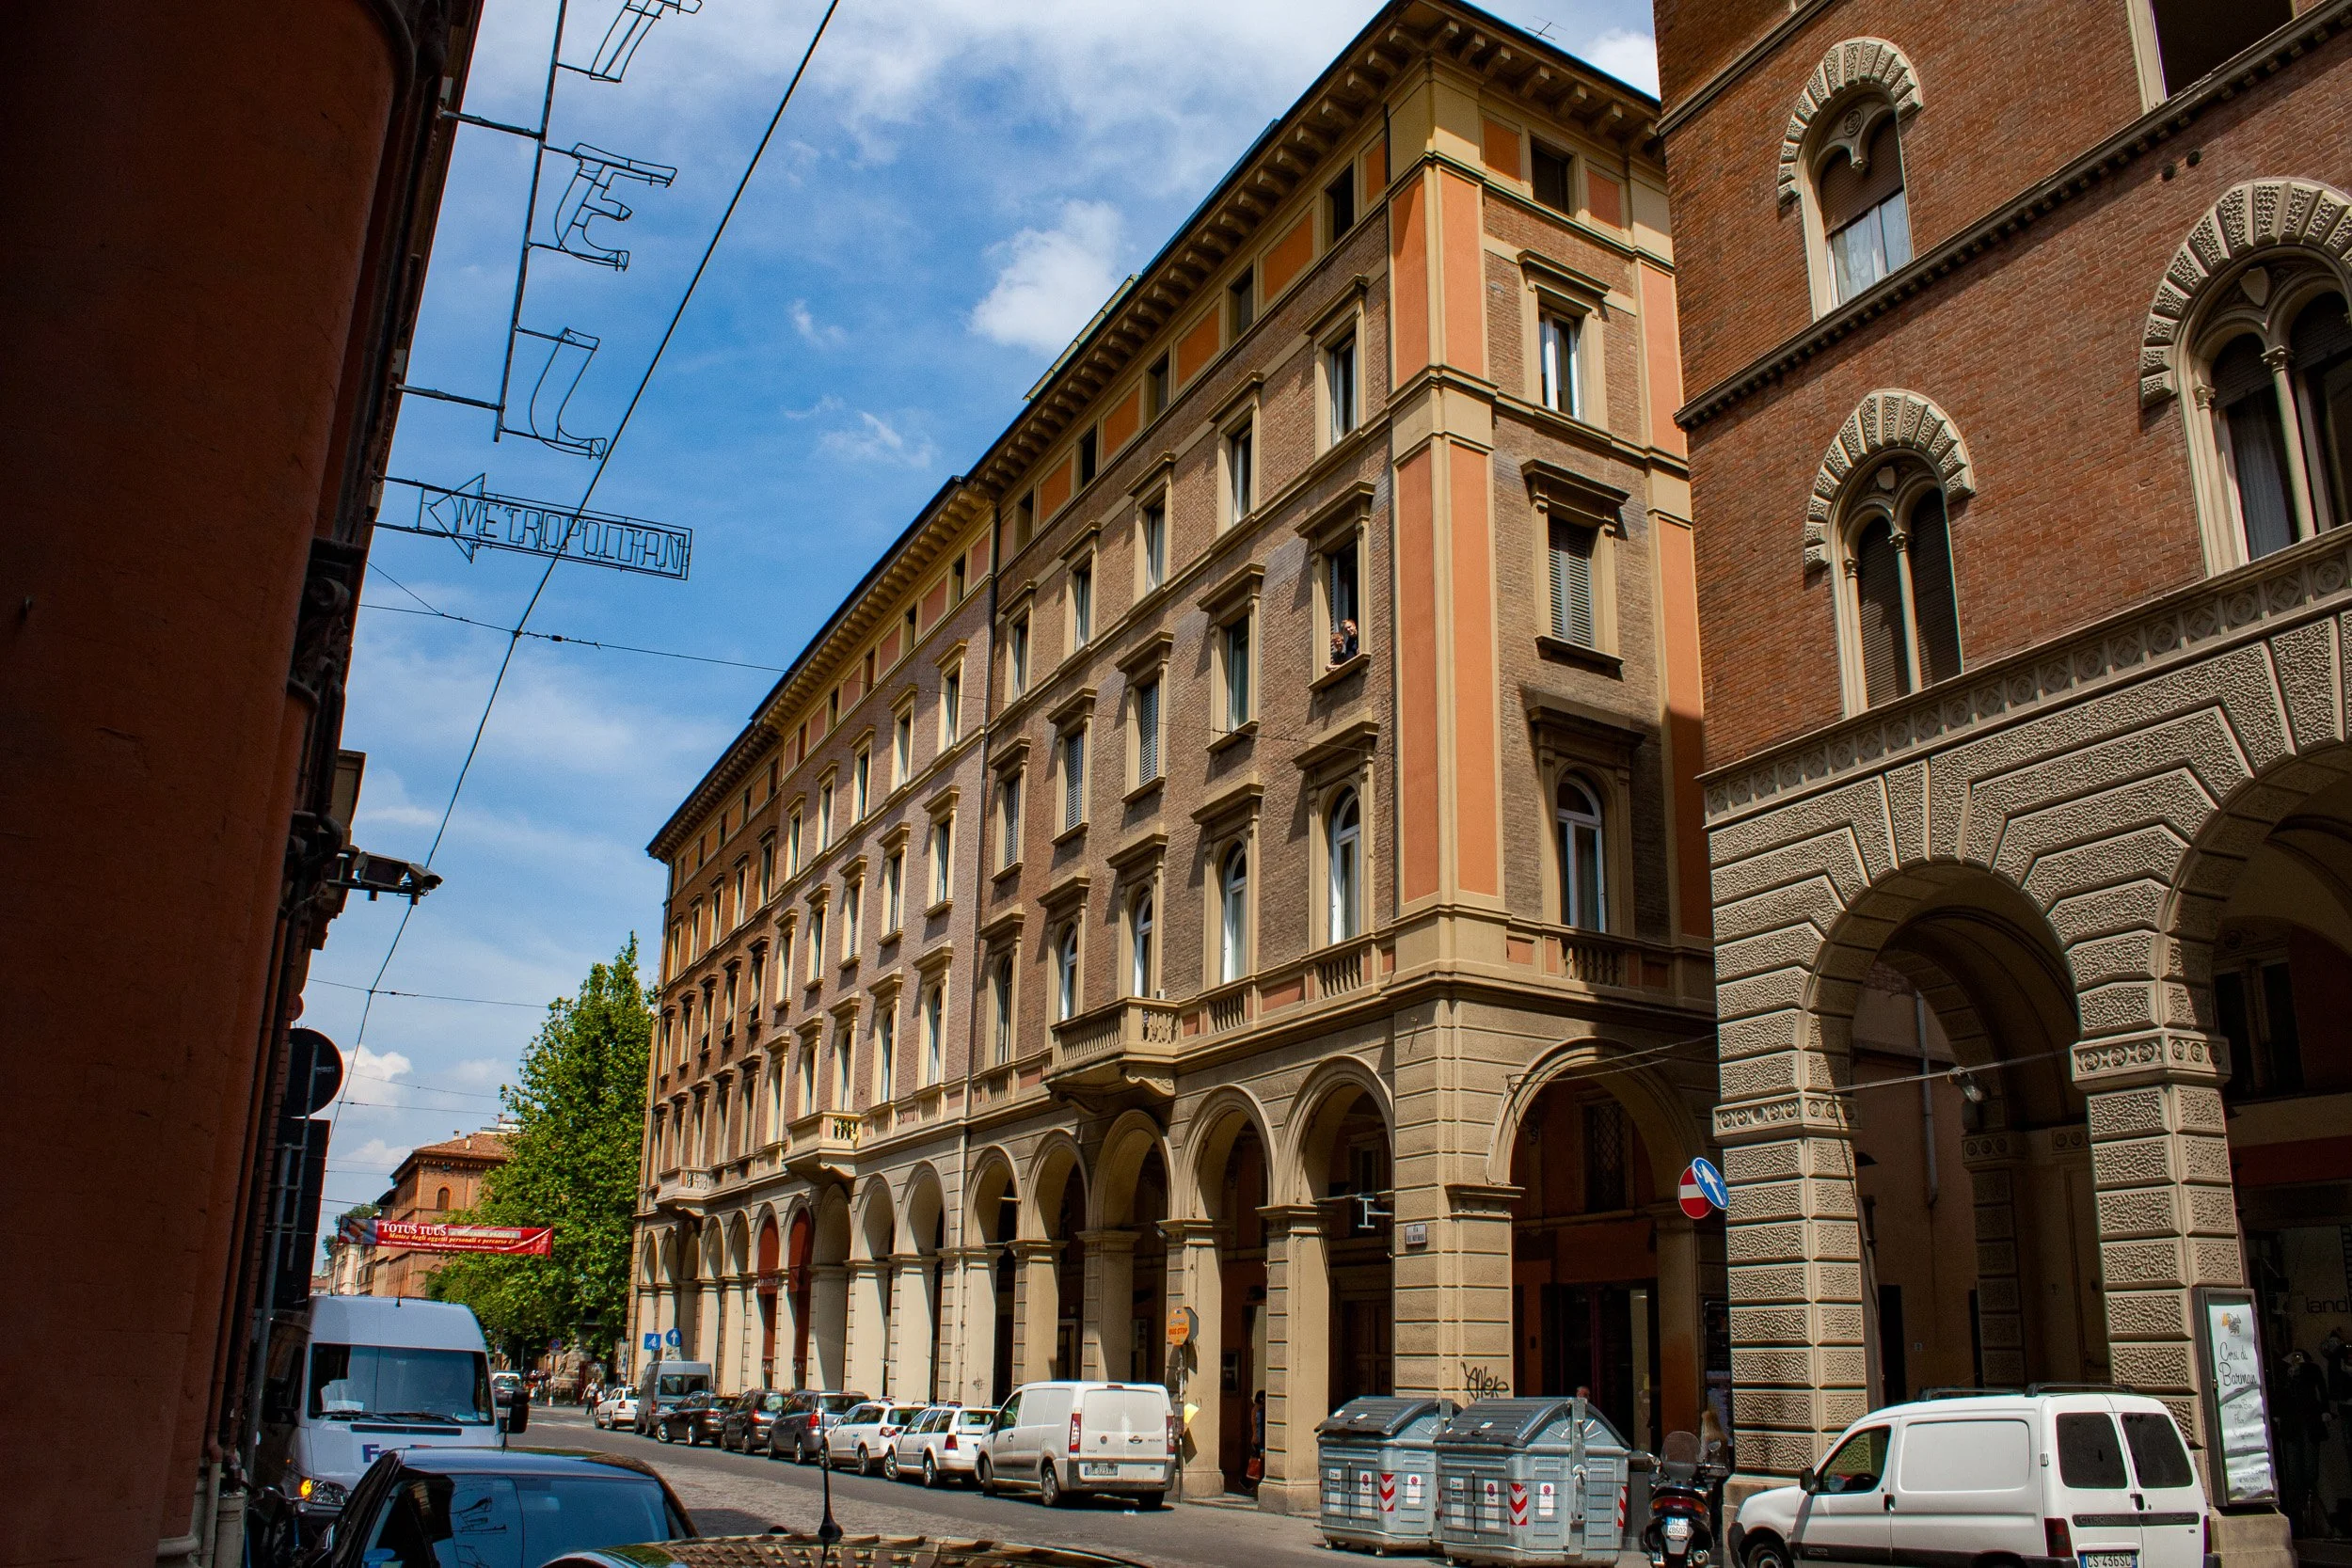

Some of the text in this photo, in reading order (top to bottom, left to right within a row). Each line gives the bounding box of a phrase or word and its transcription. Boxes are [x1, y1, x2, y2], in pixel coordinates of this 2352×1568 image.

[455, 498, 681, 570] METROPOLITAN
[382, 1223, 447, 1236] TOTUS TUUS
[411, 1233, 427, 1242] degli
[1168, 1327, 1177, 1336] BUS
[2219, 1341, 2249, 1362] Corsi di
[2217, 1361, 2257, 1386] Barman
[2087, 1554, 2132, 1568] CS 436SC
